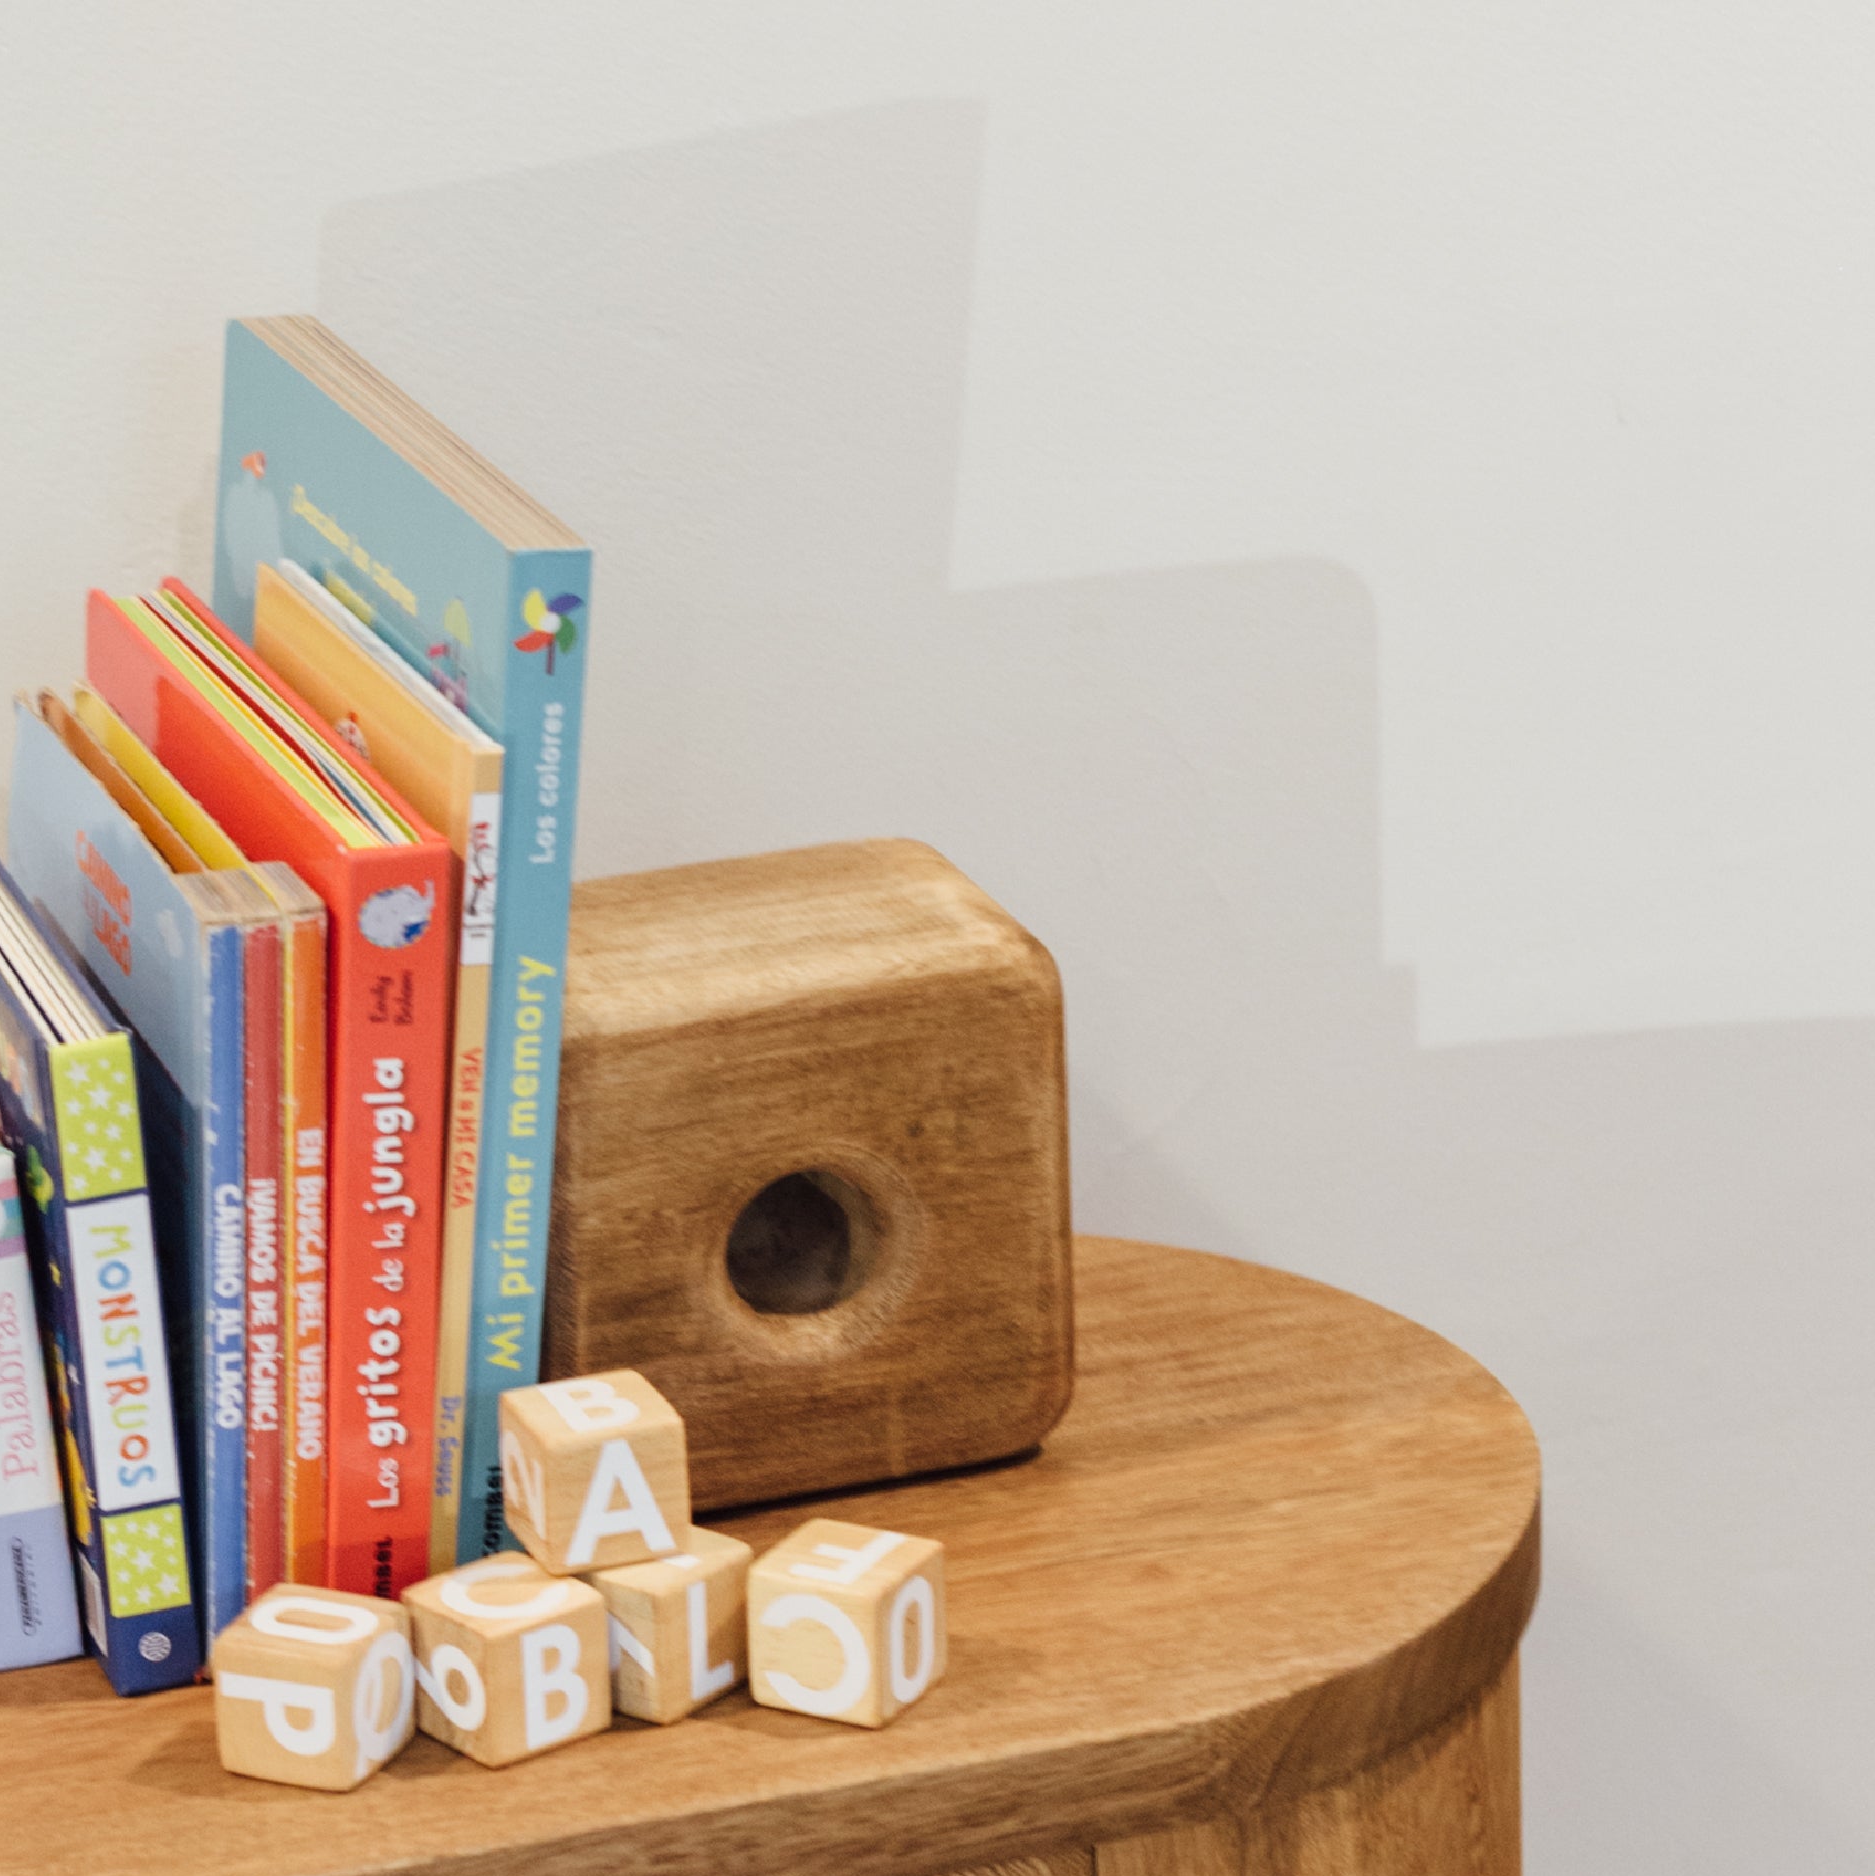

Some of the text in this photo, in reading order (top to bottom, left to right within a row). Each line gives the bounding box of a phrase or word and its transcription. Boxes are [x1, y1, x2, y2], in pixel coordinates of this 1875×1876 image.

[528, 701, 565, 864] Los colores
[460, 1046, 483, 1093] VEN
[450, 1150, 475, 1210] CASA
[454, 1117, 477, 1144] MI
[485, 954, 557, 1371] Mi primer memory
[213, 1183, 243, 1430] CAMINO AL LAGO
[248, 1290, 278, 1326] DE
[295, 1128, 324, 1461] EN BUSCA DEL VERANO
[357, 1056, 416, 1509] Los gritos de la jungla
[89, 1224, 157, 1489] MONSTRUOS
[536, 1380, 640, 1432] B
[434, 1437, 460, 1498] Seuss
[565, 1439, 676, 1567] A
[440, 1563, 570, 1619] C
[686, 1580, 734, 1700] L
[219, 1670, 336, 1756] P
[520, 1623, 589, 1750] B
[759, 1593, 871, 1716] C
